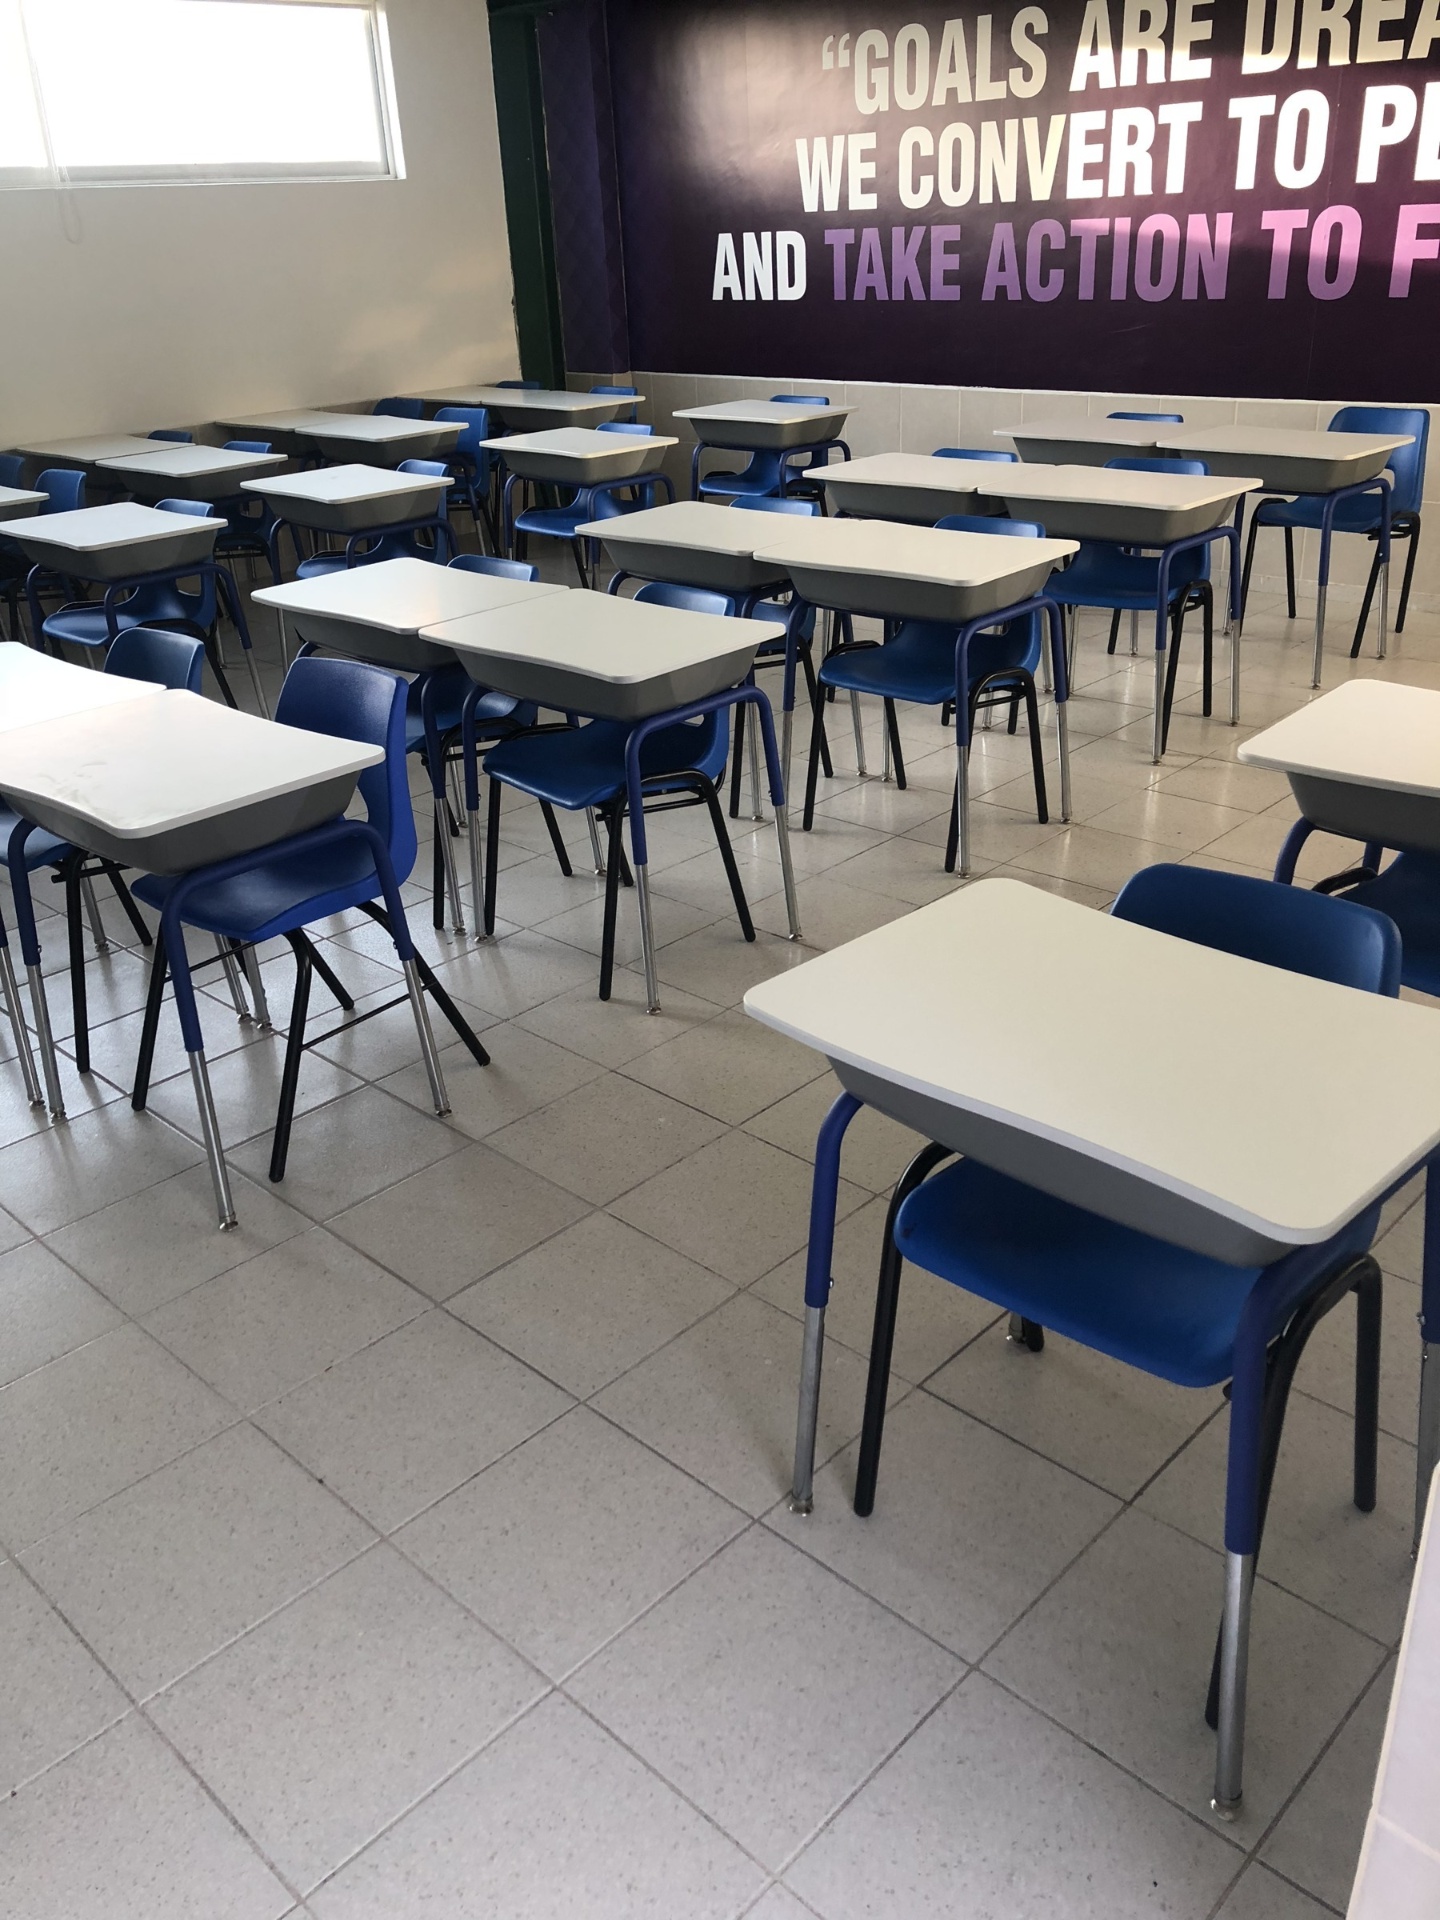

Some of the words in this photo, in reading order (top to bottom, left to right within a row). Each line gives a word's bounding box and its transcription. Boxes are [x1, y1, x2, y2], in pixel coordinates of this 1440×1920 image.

[822, 5, 1048, 114] “GOALS
[1069, 0, 1214, 92] ARE
[795, 132, 877, 213] WE
[899, 101, 1202, 210] CONVERT
[1228, 89, 1329, 191] TO
[712, 230, 806, 301] AND
[824, 225, 961, 301] TAKE
[981, 212, 1233, 302] ACTION
[1261, 204, 1362, 300] TO
